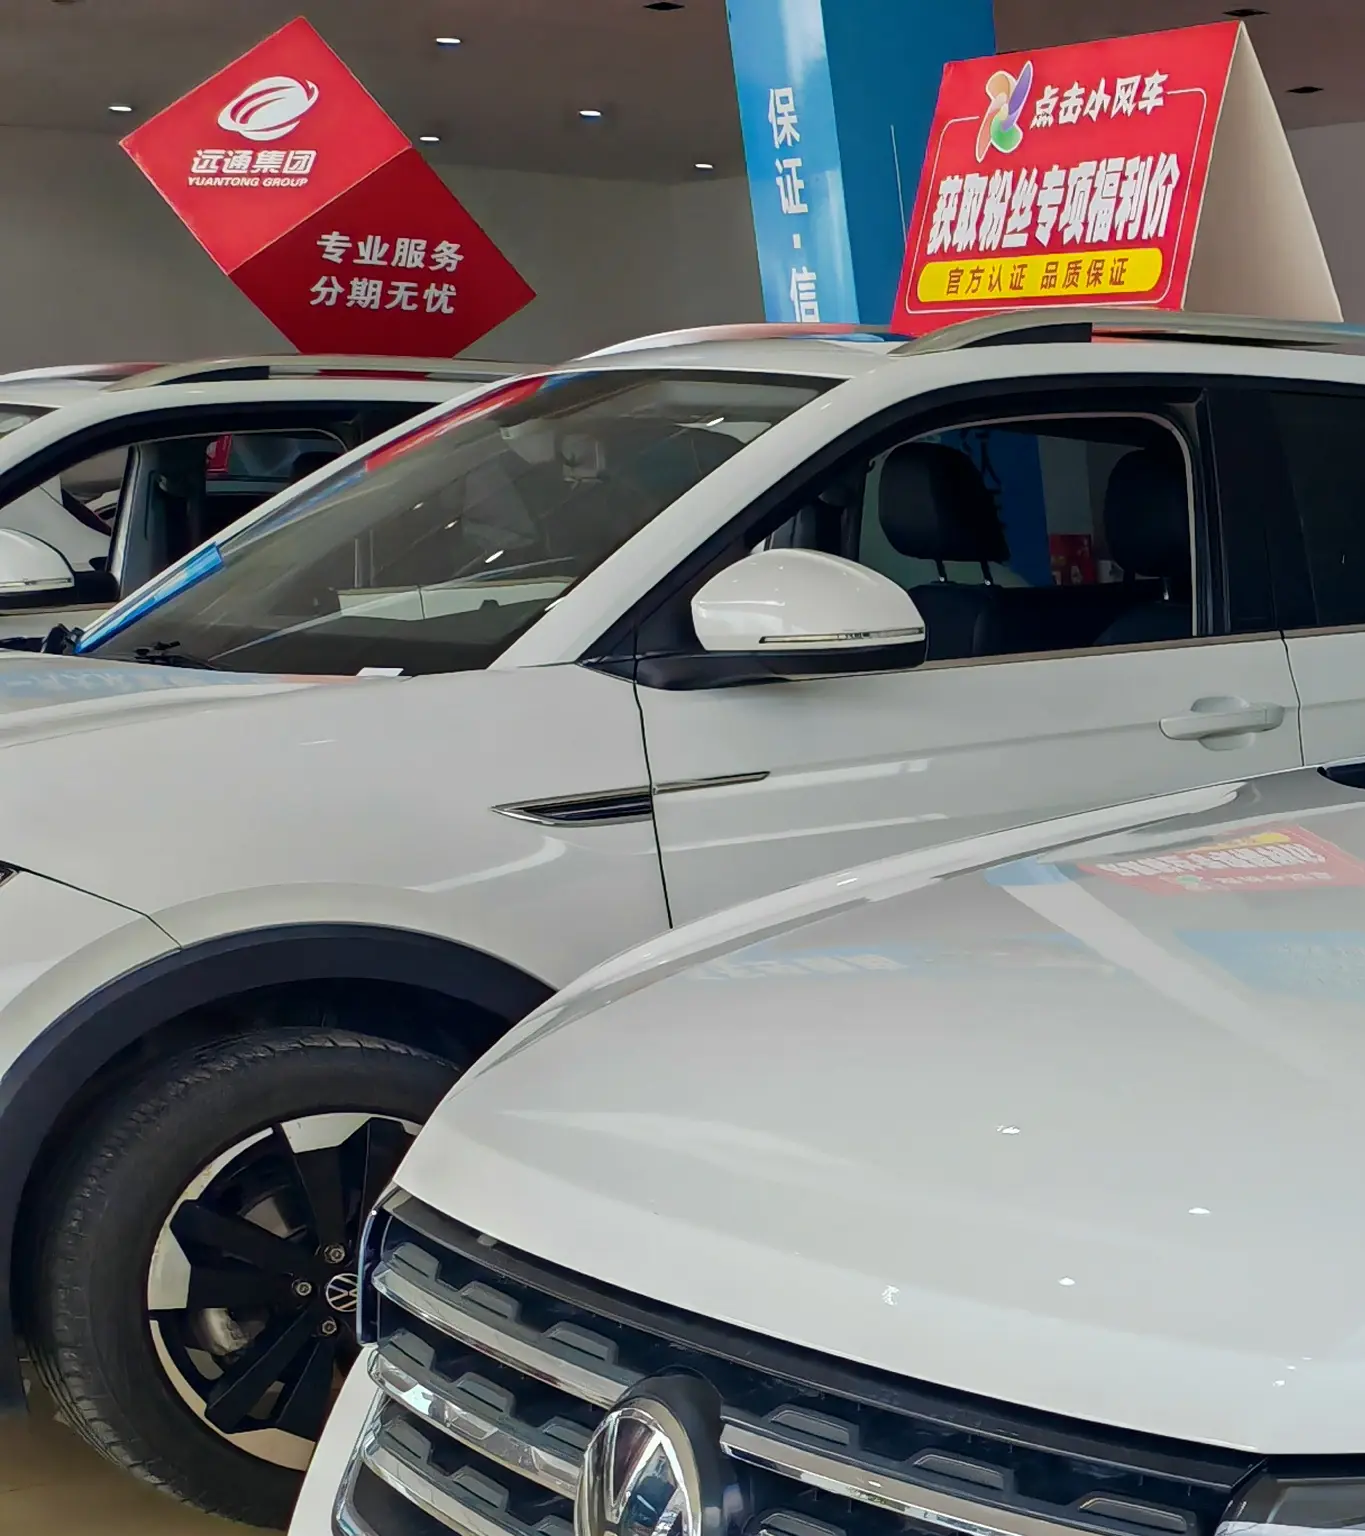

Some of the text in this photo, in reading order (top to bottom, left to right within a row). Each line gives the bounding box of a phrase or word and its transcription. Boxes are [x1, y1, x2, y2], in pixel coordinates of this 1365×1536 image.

[1029, 70, 1168, 131] 点击小风车
[188, 176, 309, 188] YUANTONG GROUP
[191, 149, 317, 176] 远通集团
[926, 152, 1182, 256] 获取粉丝专项福利价
[316, 231, 465, 273] 专业服务
[309, 275, 458, 315] 分期无忧
[945, 255, 1130, 297] 官方认证 品质保证
